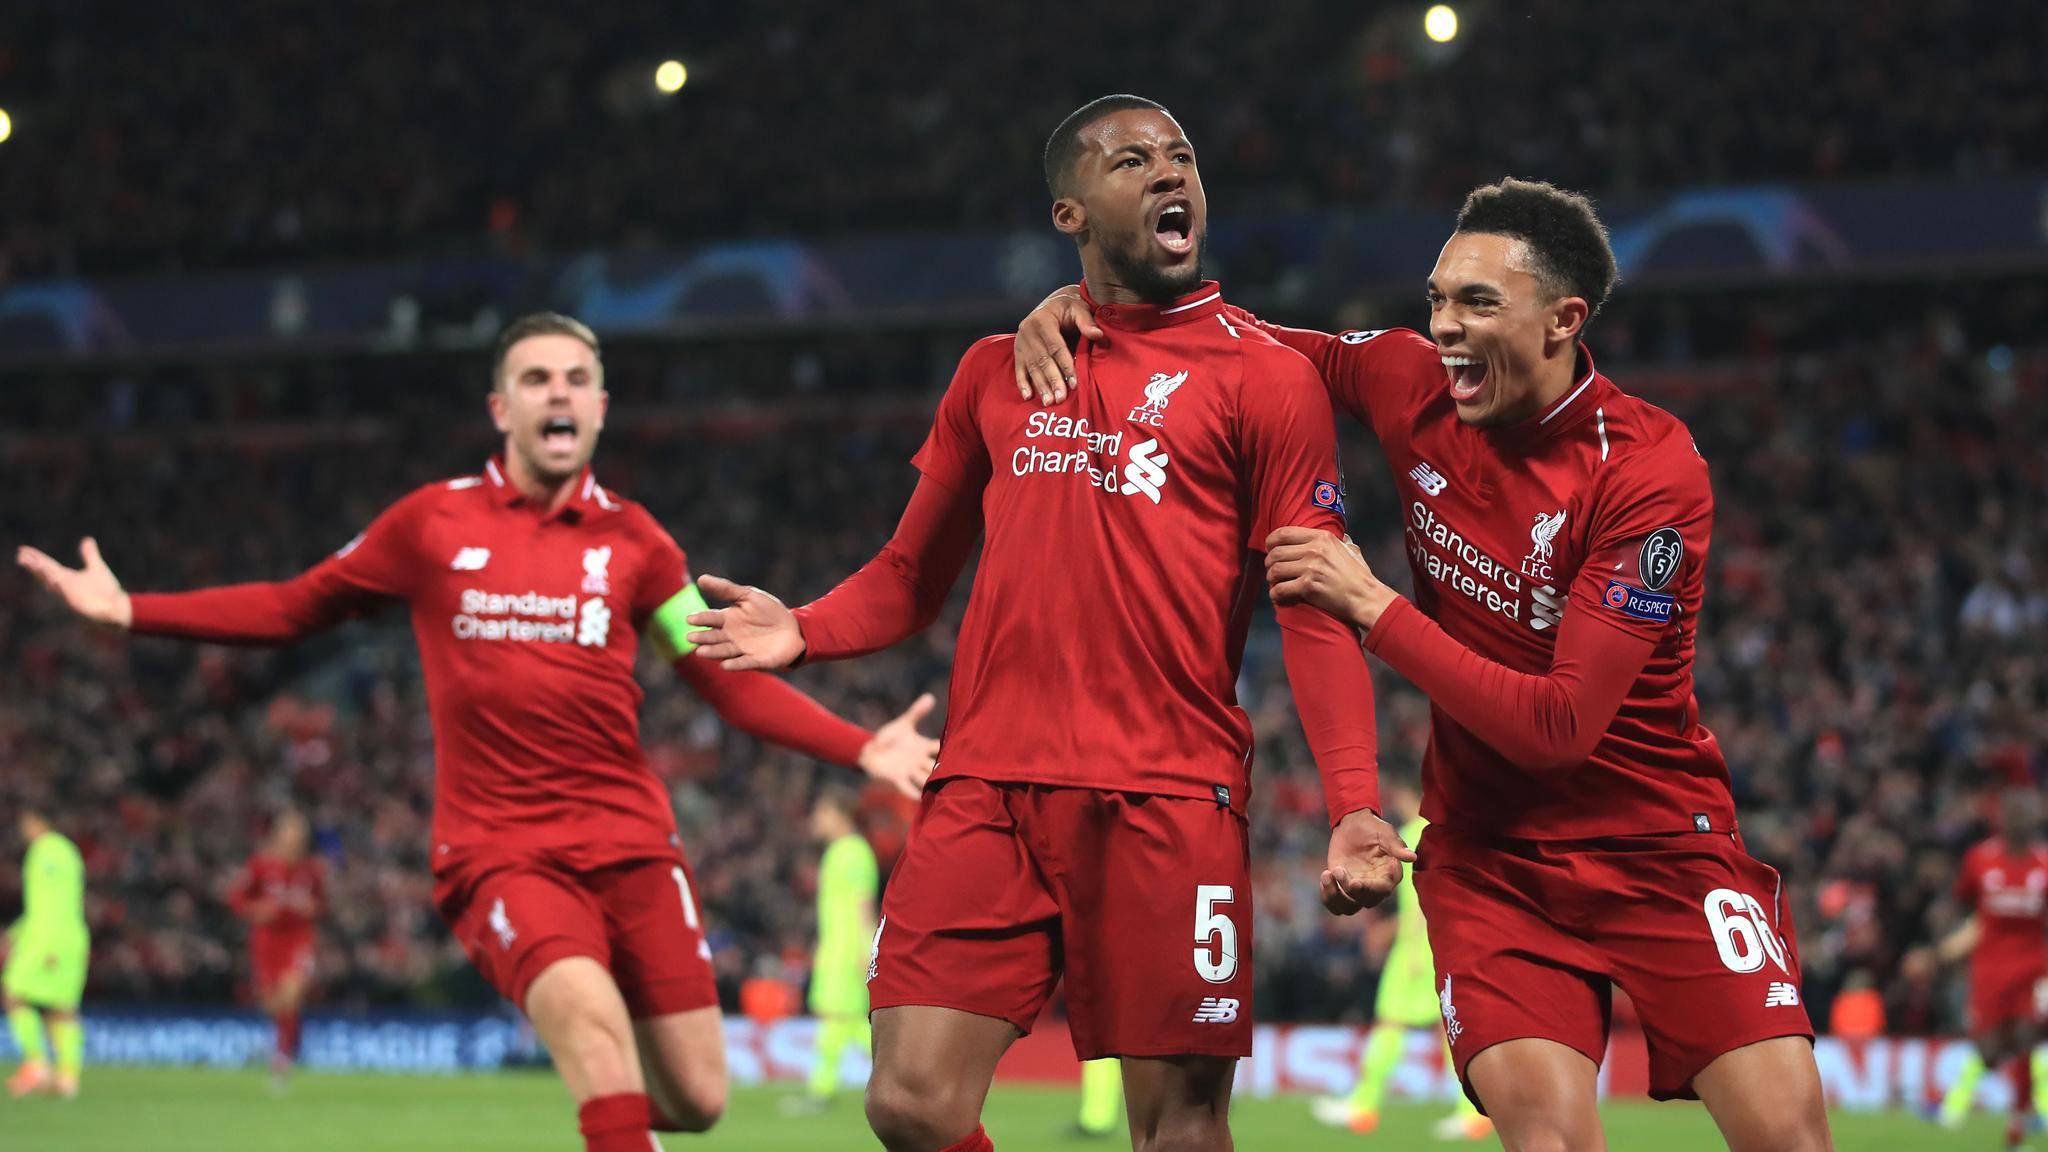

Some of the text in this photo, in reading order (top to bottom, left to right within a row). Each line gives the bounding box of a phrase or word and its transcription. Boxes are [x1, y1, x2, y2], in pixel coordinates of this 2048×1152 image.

[1025, 411, 1123, 456] Staard
[1411, 501, 1521, 593] Standard
[1520, 560, 1554, 581] L.F.C.
[1654, 558, 1667, 575] 5
[461, 588, 577, 618] Standard
[1628, 596, 1672, 615] RESPECT
[452, 614, 576, 642] Chartered
[1193, 885, 1239, 984] 5
